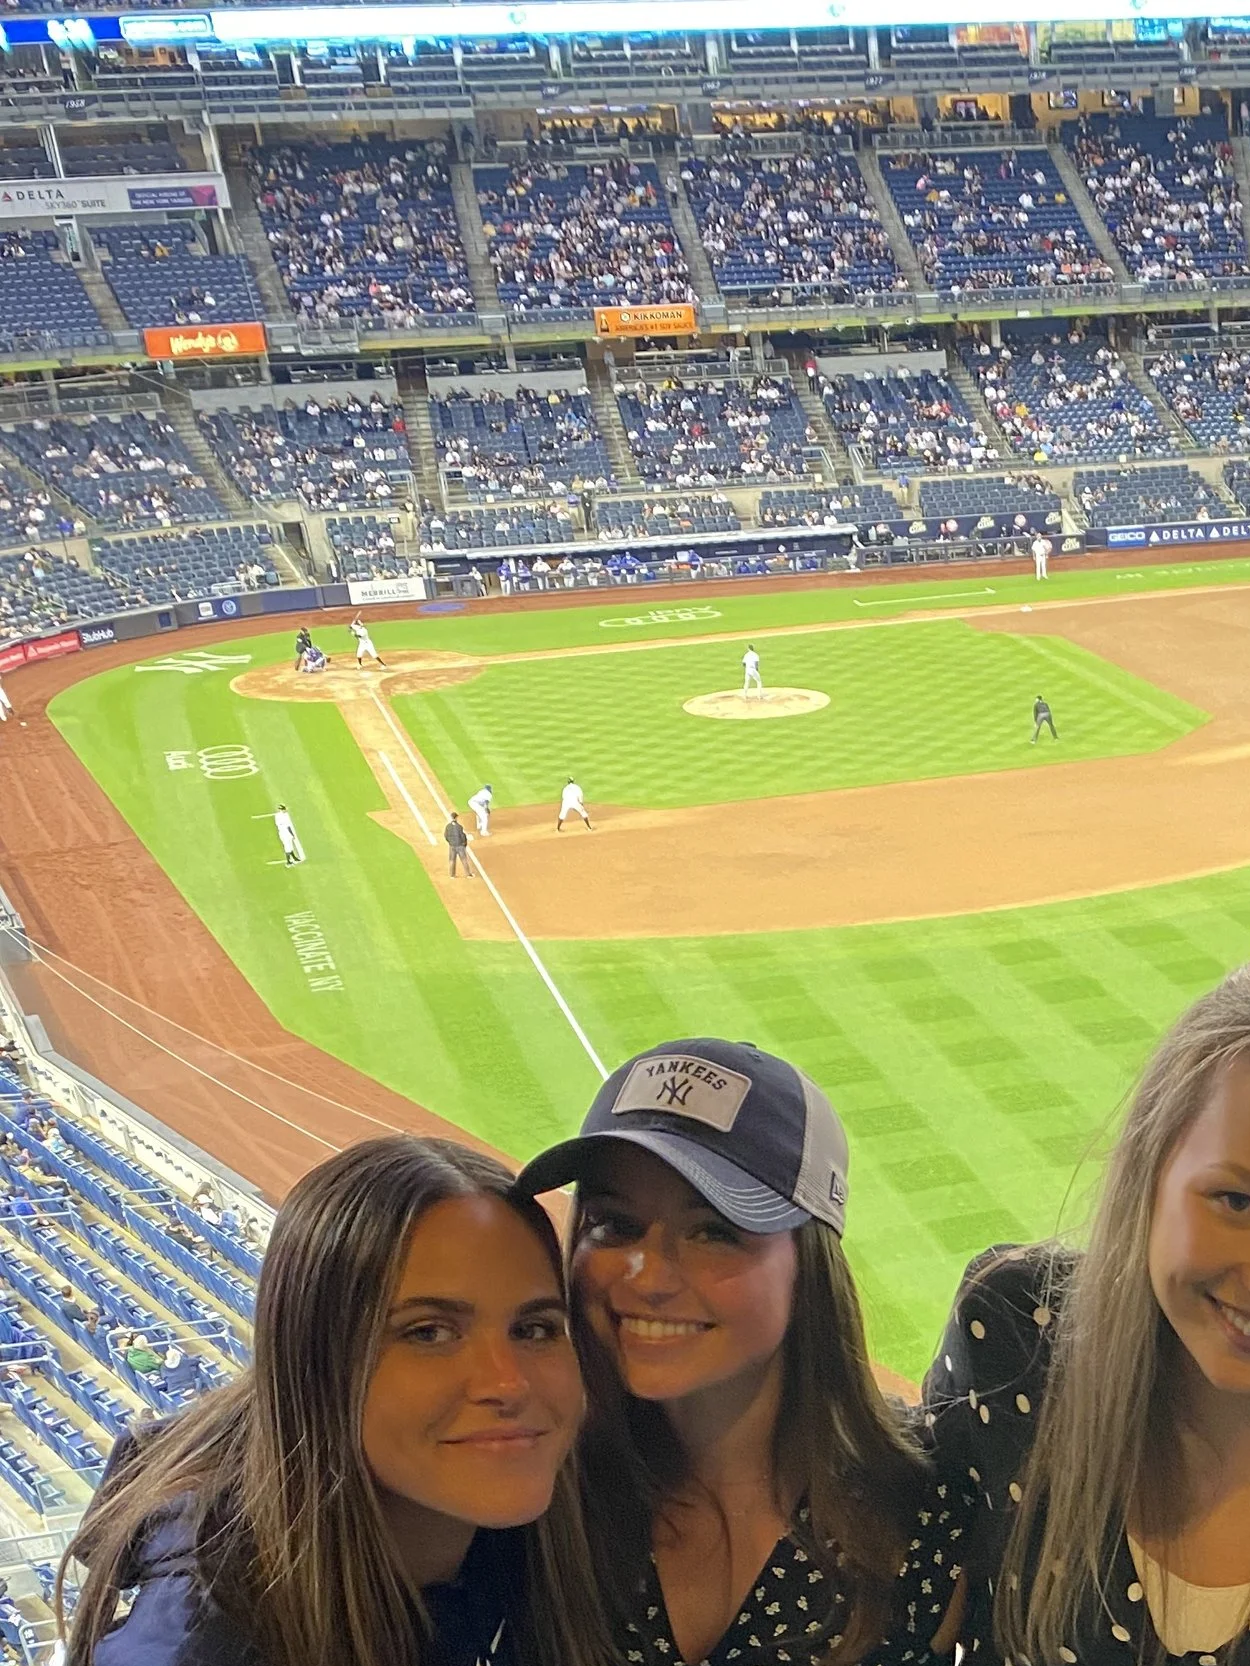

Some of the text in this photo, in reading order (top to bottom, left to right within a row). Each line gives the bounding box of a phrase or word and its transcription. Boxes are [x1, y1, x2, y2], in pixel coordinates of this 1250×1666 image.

[16, 188, 65, 201] DELTA
[633, 311, 683, 321] KIKKOMAN
[1108, 531, 1146, 542] GEICO
[1162, 527, 1205, 541] DELTA
[82, 628, 114, 643] StubHub
[284, 910, 345, 993] VACCINATE NY
[645, 1060, 728, 1091] YANKEES
[656, 1075, 694, 1107] NY
